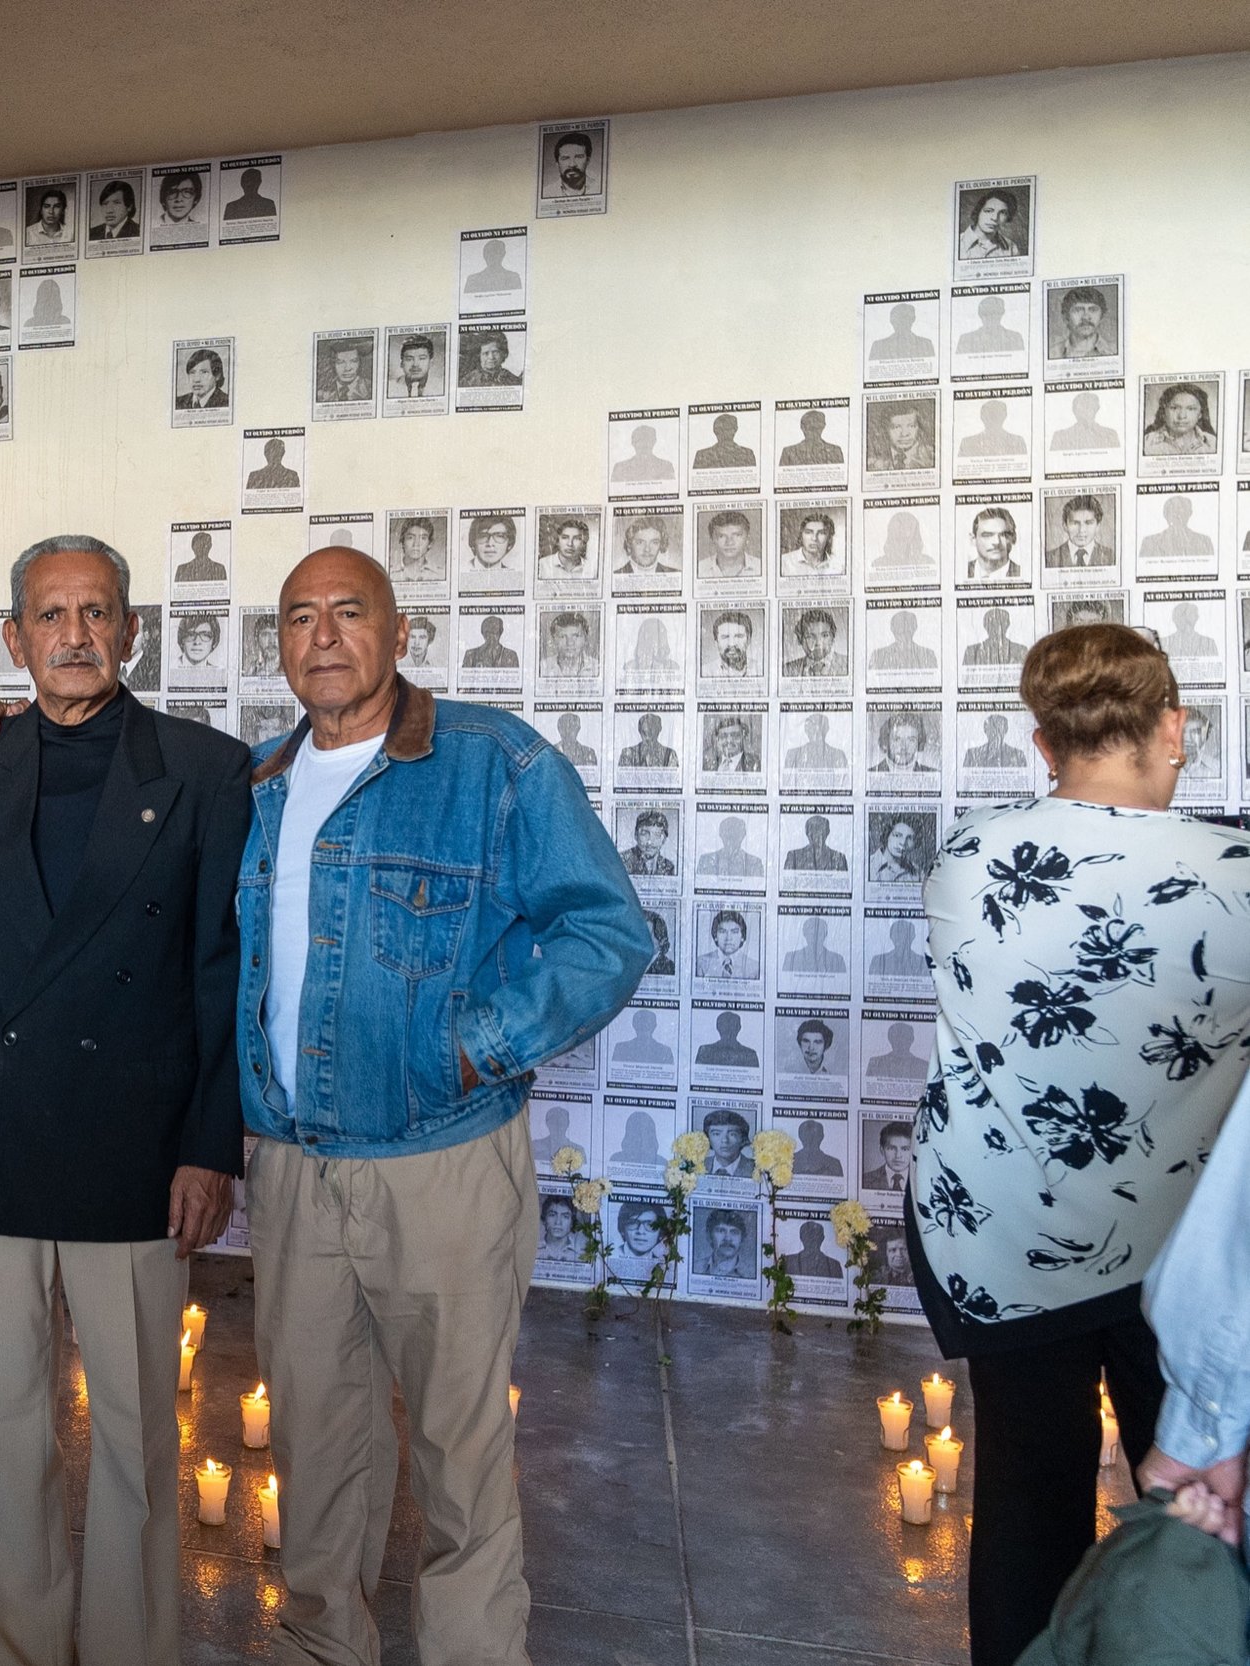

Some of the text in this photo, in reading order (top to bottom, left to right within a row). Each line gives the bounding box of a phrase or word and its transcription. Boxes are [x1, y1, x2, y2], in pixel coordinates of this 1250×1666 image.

[963, 286, 989, 295] OLVIDO
[990, 285, 999, 293] NI
[875, 293, 900, 302] OLVIDO
[901, 293, 910, 301] NI
[1056, 382, 1082, 390] OLVIDO
[966, 390, 991, 398] OLVIDO
[992, 389, 1002, 397] NI
[699, 404, 722, 413] OLVIDO
[723, 404, 732, 412] NI
[786, 400, 810, 409] OLVIDO
[811, 400, 820, 408] NI
[1148, 484, 1175, 492] OLVIDO
[614, 1097, 638, 1105] OLVIDO
